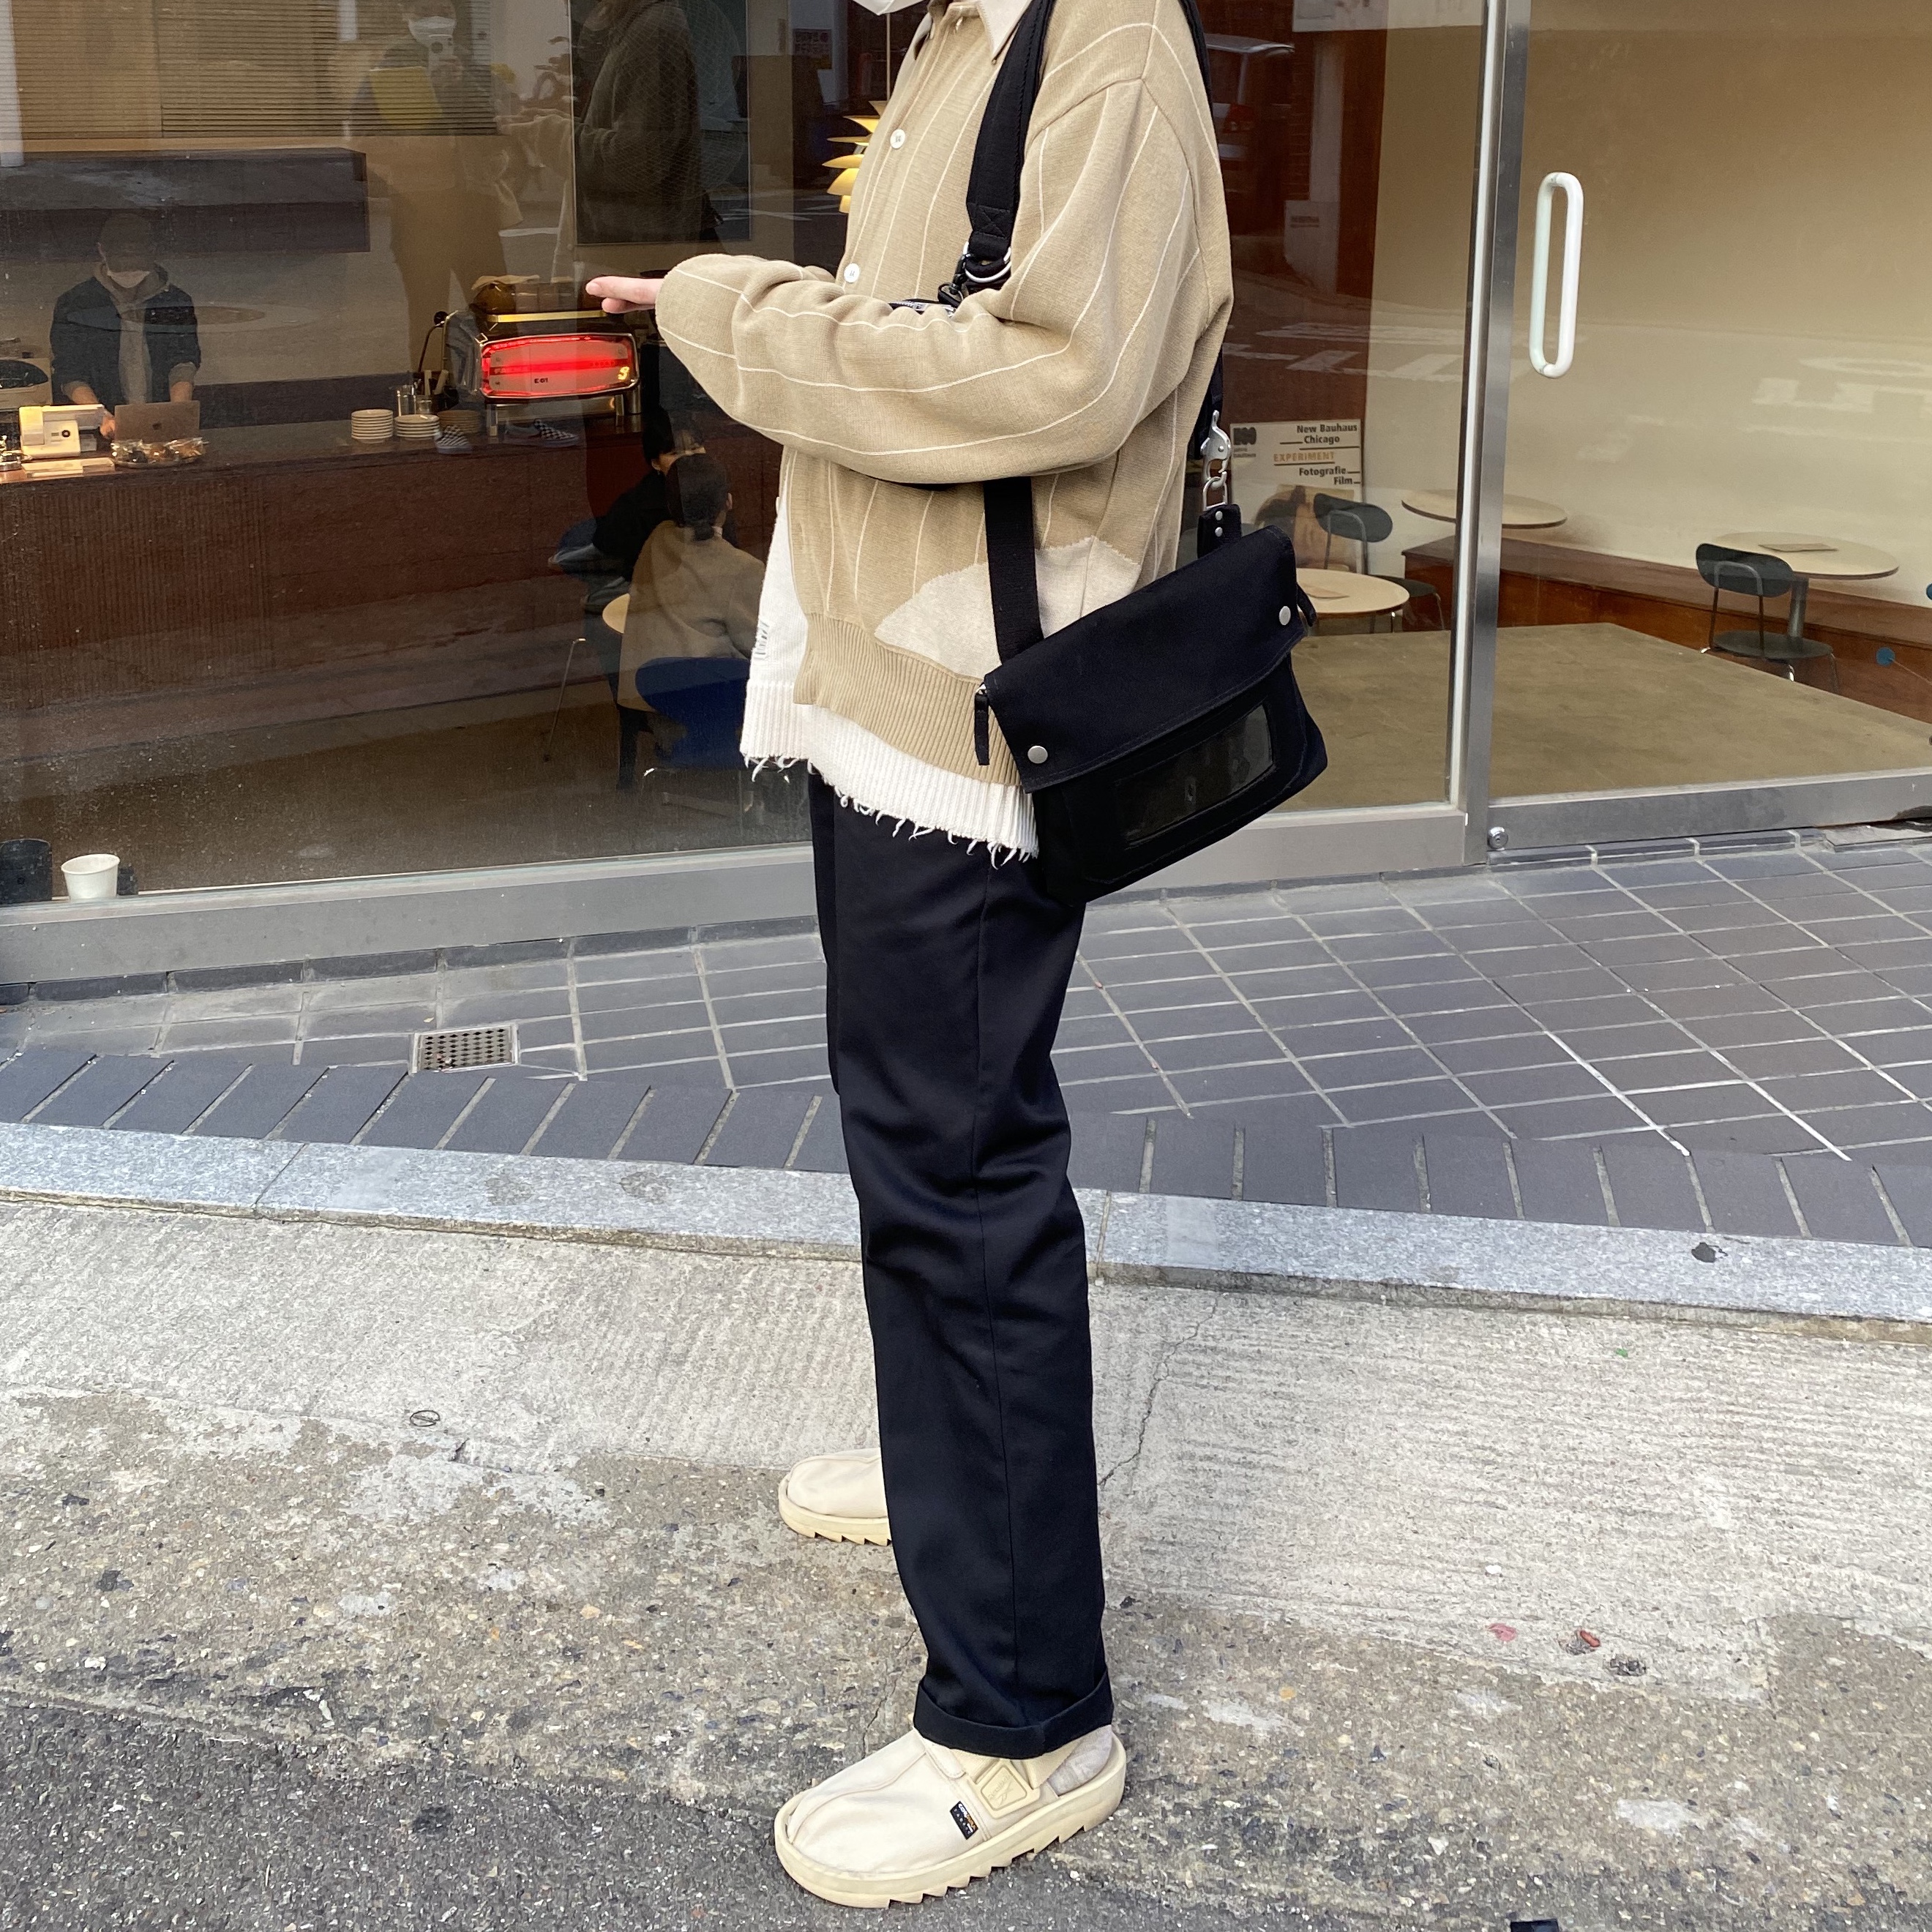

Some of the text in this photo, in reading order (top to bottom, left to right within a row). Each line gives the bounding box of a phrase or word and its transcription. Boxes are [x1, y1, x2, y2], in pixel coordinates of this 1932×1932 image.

[1297, 423, 1358, 433] New Bauhaus
[1304, 435, 1340, 445] Chicago
[1273, 452, 1334, 462] EXPERIMENT
[1299, 465, 1347, 477] Fotografie
[1333, 476, 1353, 484] Film
